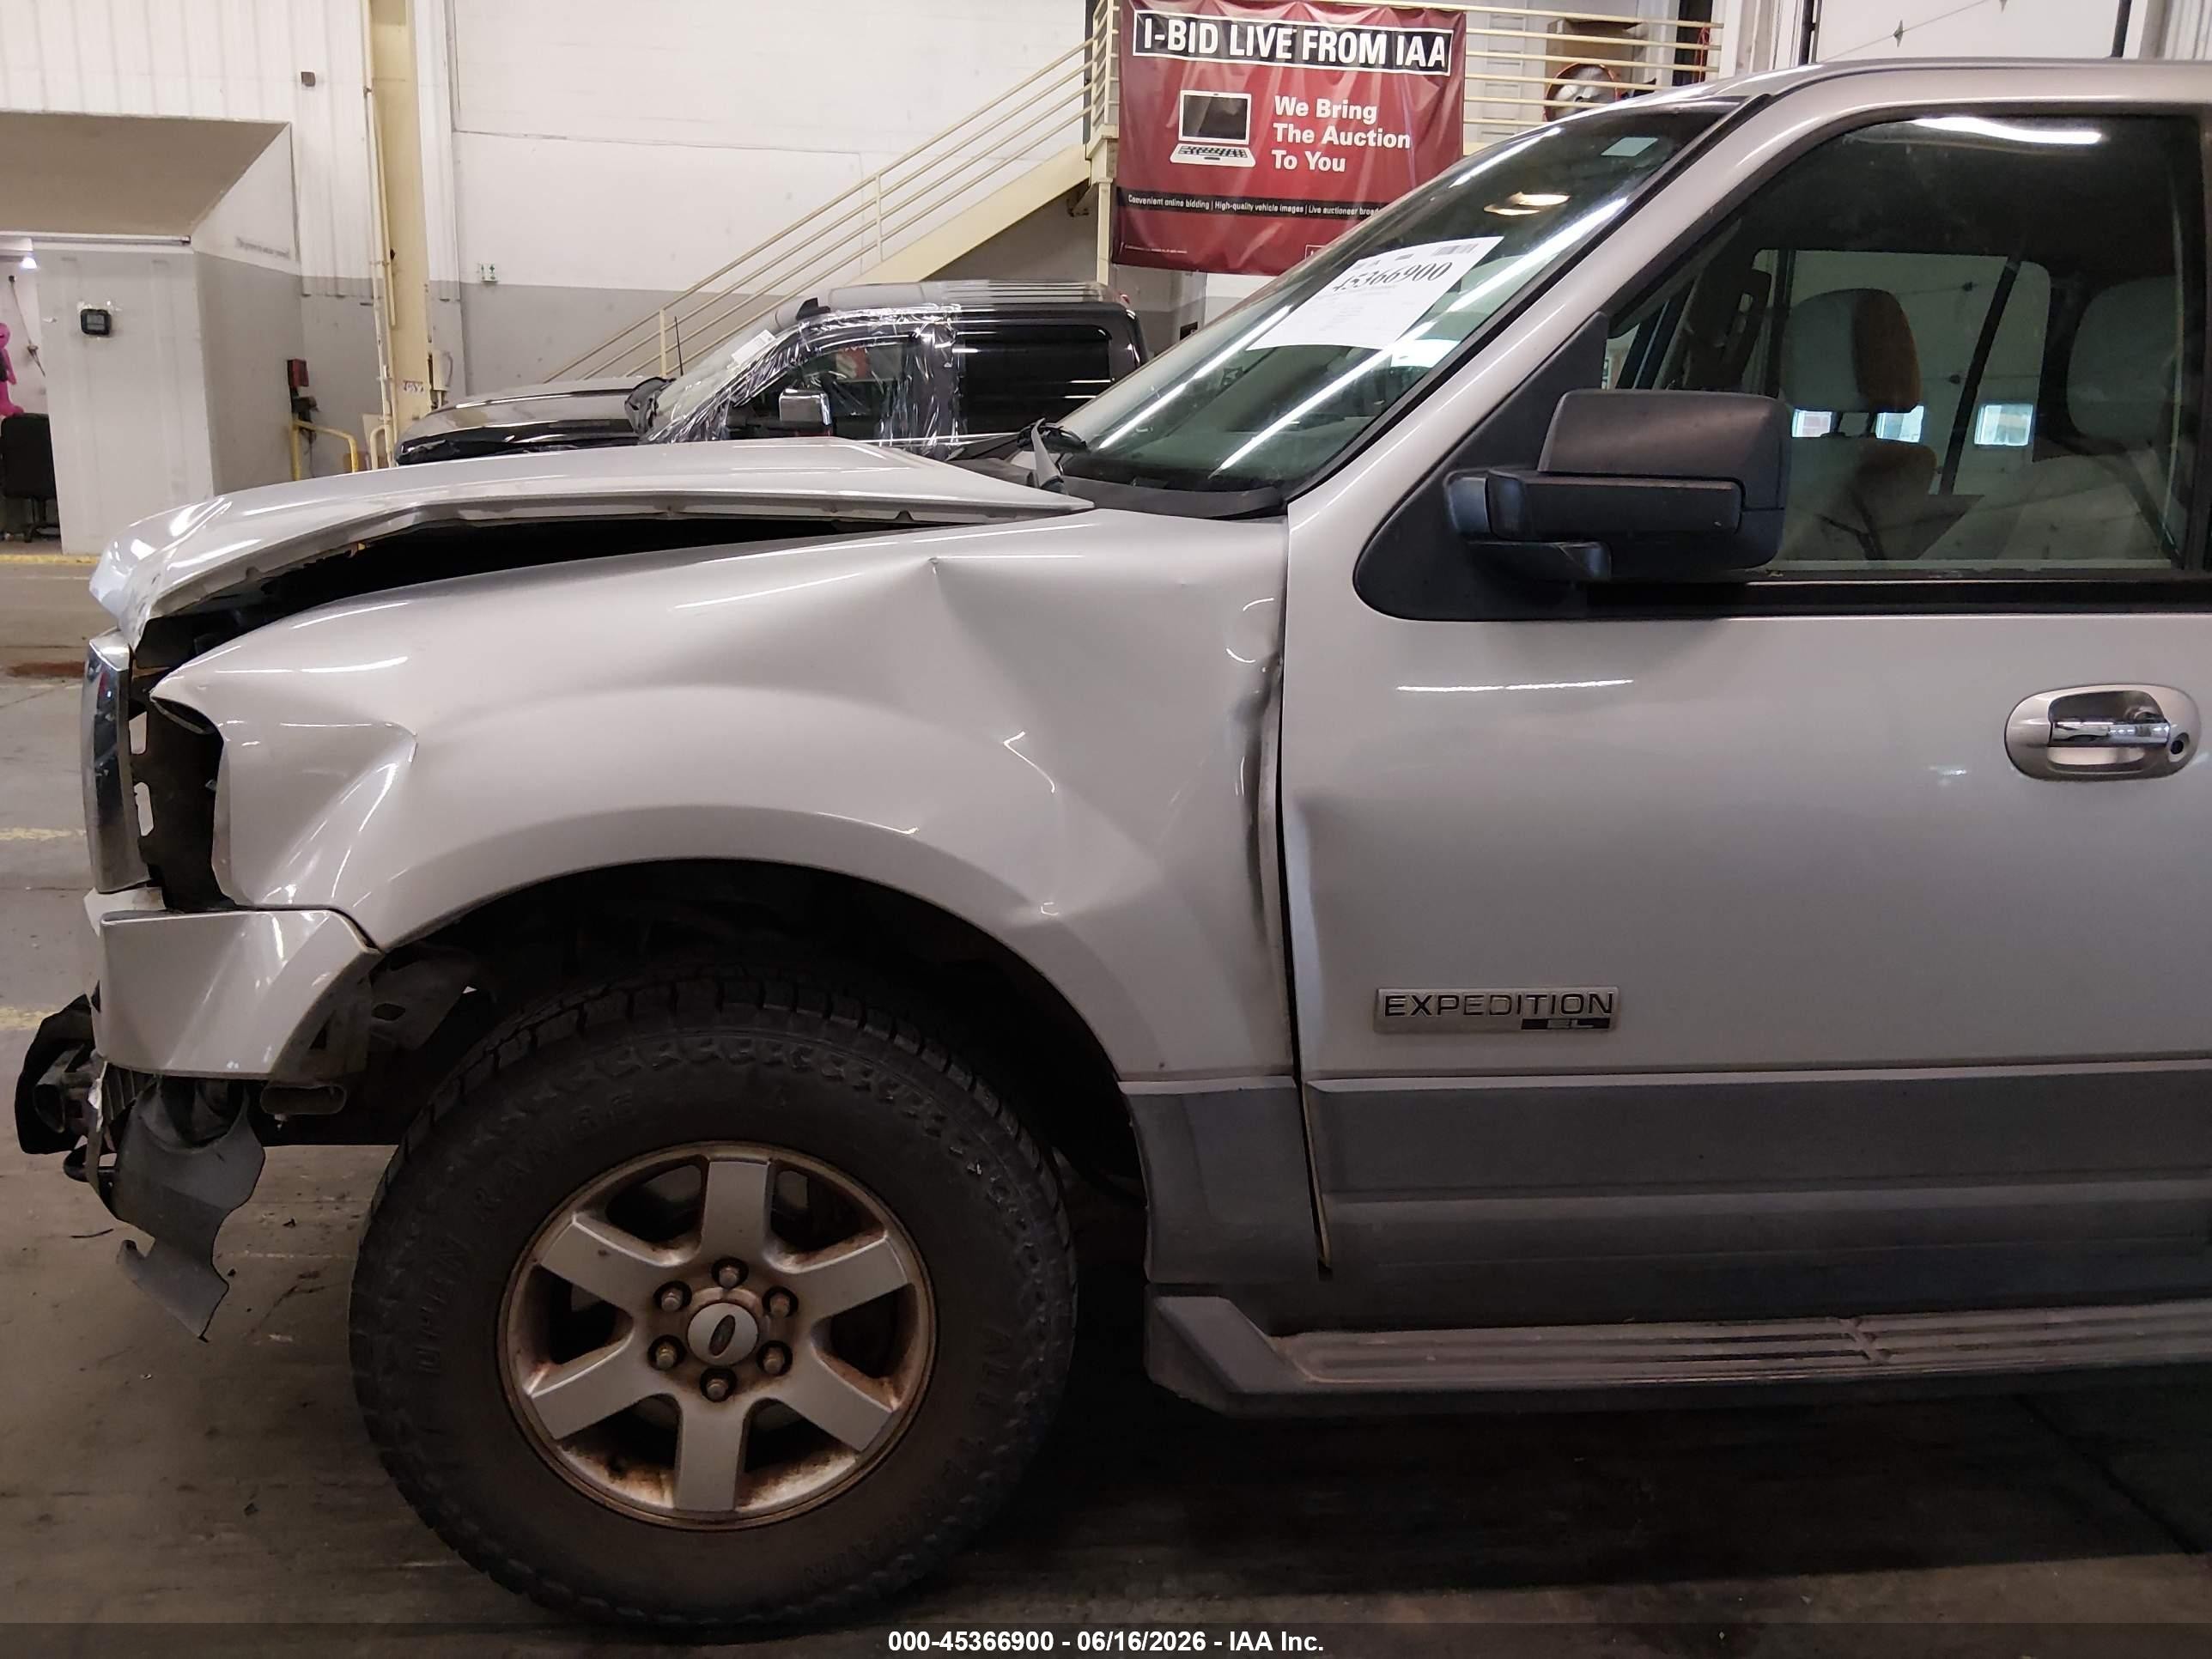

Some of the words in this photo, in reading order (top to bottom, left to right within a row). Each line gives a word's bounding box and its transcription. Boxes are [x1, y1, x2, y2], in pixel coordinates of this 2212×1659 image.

[1144, 17, 1219, 54] I-BID
[1229, 23, 1293, 59] LIVE
[1302, 28, 1386, 66] FROM
[1395, 34, 1446, 68] IAA
[1274, 95, 1310, 117] We
[1316, 98, 1377, 125] Bring
[1273, 122, 1316, 143] The
[1321, 125, 1411, 149] Auction
[1271, 149, 1298, 170] To
[1304, 150, 1346, 172] You
[1127, 194, 1164, 206] Convenient
[1164, 198, 1184, 207] online
[1185, 198, 1210, 210] bidding
[1214, 200, 1254, 212] High-quality
[1255, 204, 1279, 212] vehicle
[1279, 204, 1304, 214] images
[1308, 204, 1322, 214] Live
[1322, 205, 1358, 216] auctioneer
[1384, 992, 1614, 1018] EXPEDITION
